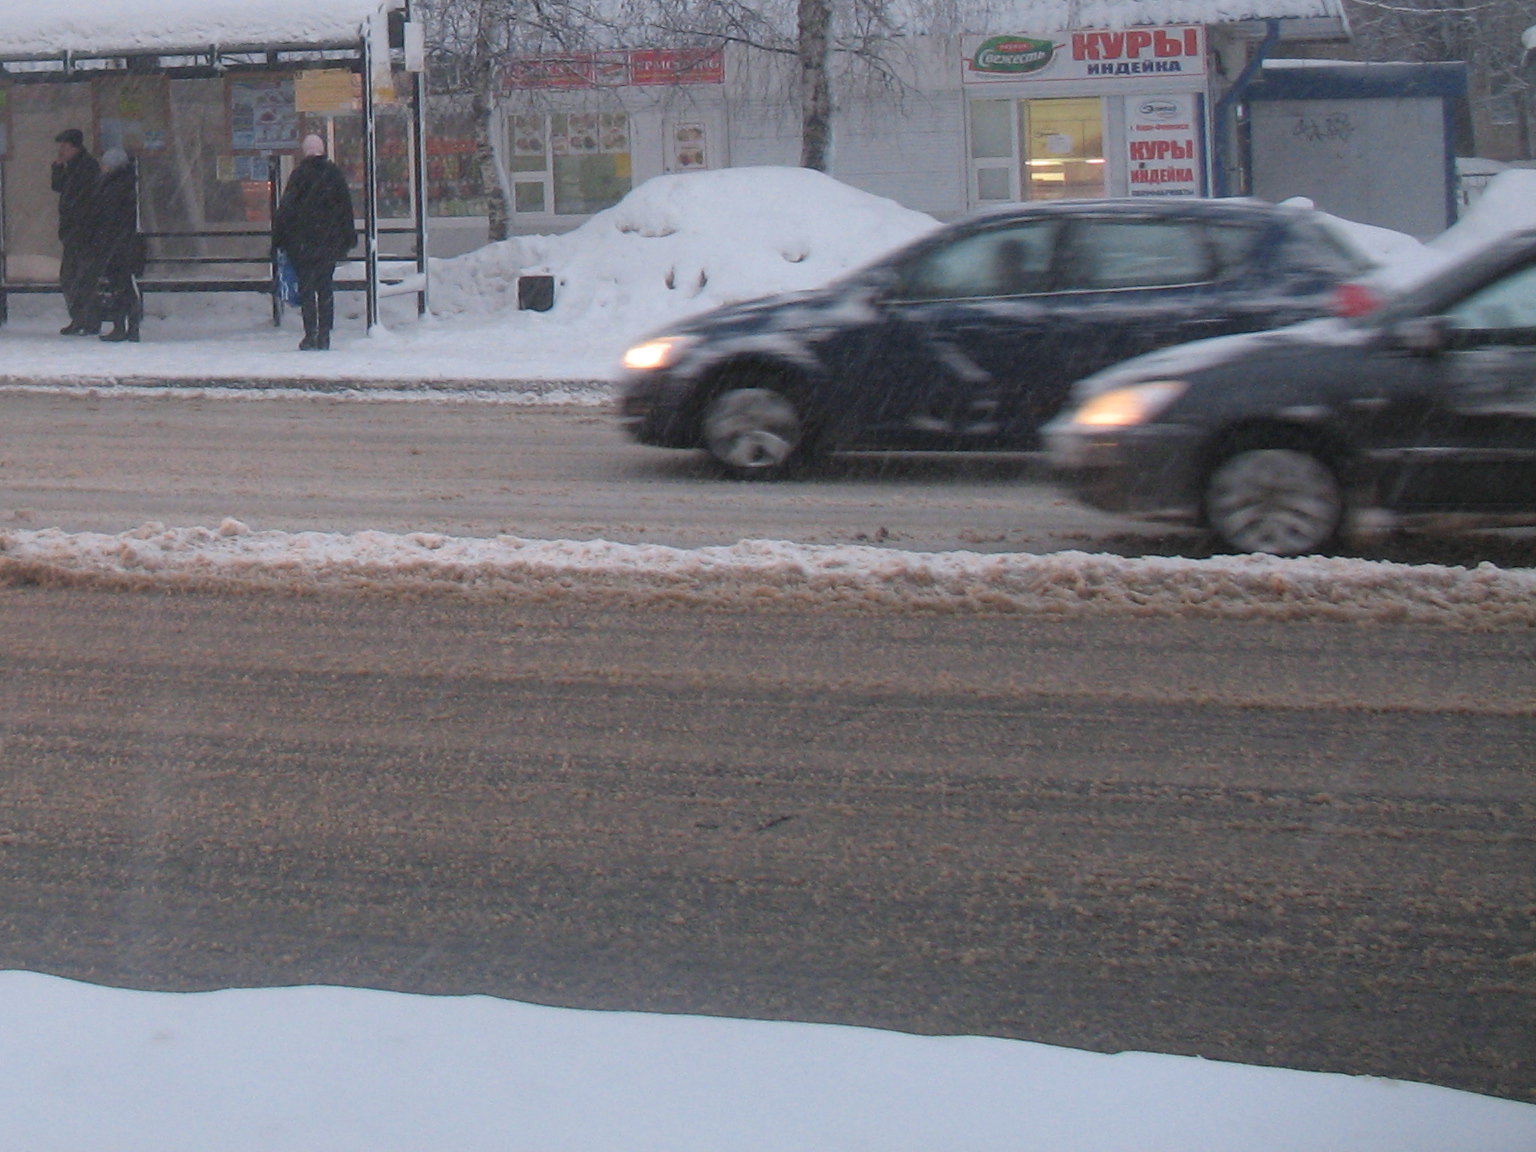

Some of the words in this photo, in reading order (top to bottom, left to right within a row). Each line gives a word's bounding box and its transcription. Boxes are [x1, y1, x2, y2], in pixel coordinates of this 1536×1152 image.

[1072, 28, 1198, 61] КУРЫ
[978, 49, 1046, 67] Свежесть
[1087, 60, 1182, 76] ИНДЕЙКА
[1130, 139, 1193, 161] КУРЫ
[1131, 166, 1194, 185] ИНДЕЙКА
